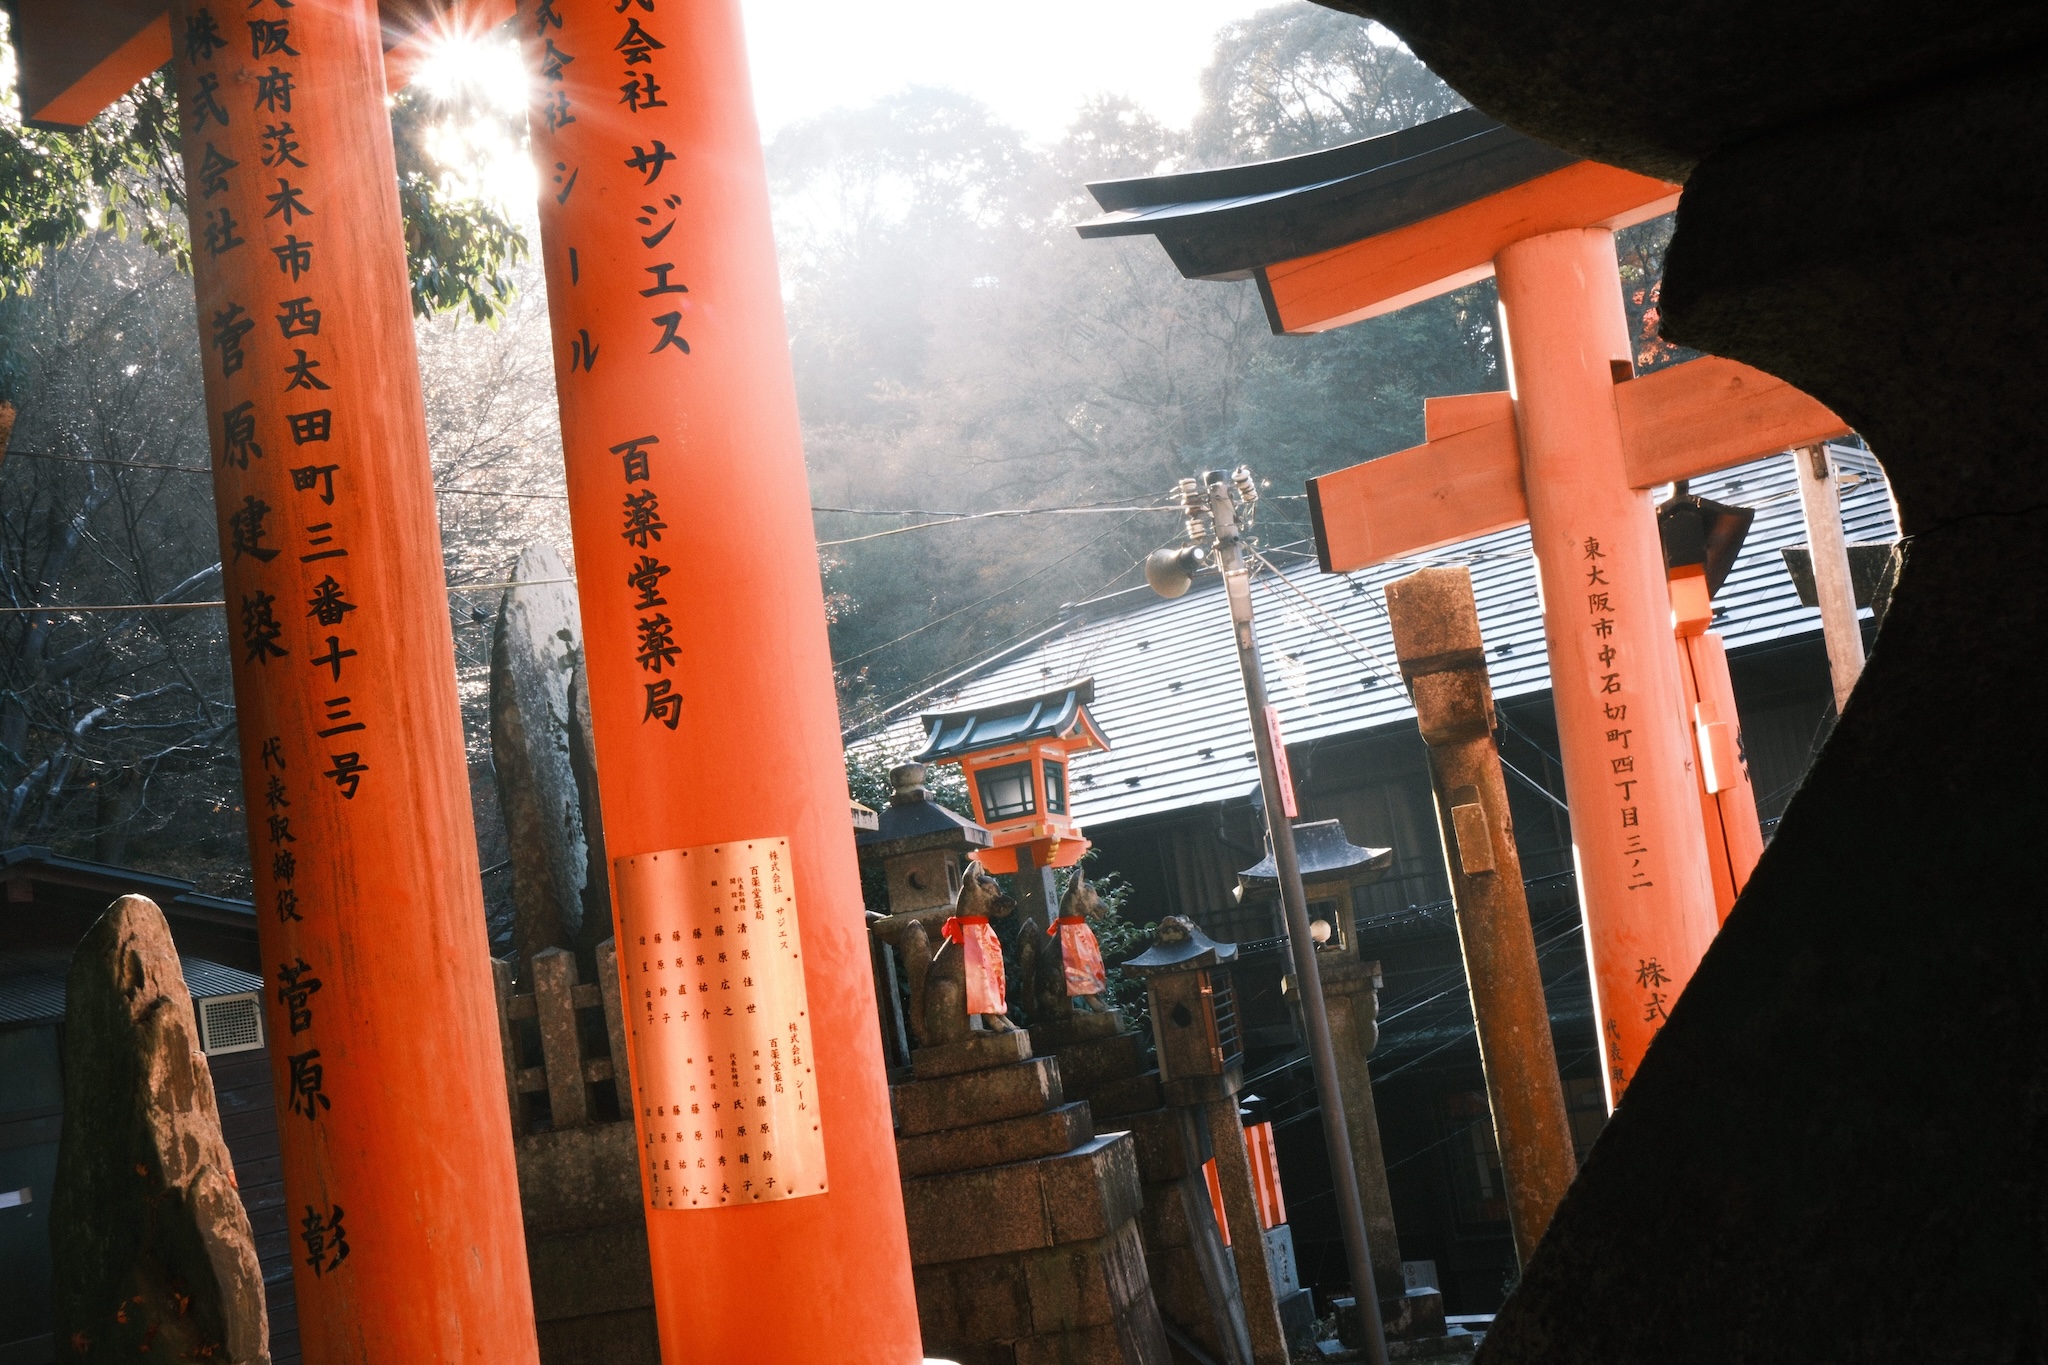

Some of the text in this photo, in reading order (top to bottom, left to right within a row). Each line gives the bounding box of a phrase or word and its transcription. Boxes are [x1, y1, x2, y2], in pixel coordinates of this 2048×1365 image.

[185, 8, 246, 260] 株式会社
[552, 160, 600, 374] シール
[246, 0, 370, 801] 阪府茨木市西太田町三番十三号
[607, 0, 691, 731] 会社 サジエス 百薬堂薬局
[210, 301, 290, 667] 菅原建築
[259, 735, 304, 924] 代表取締役
[749, 865, 765, 921] 百薬堂薬局
[769, 850, 789, 950] 株式会社 サジエス
[672, 930, 690, 1022] 藤原直子
[714, 924, 735, 1017] 藤原広之
[738, 922, 757, 1014] 清原佳世
[769, 1037, 784, 1094] 百薬堂薬局
[788, 1022, 807, 1111] 株式会社 シール
[691, 1103, 710, 1195] 藤原広之
[711, 1101, 731, 1194] 中川秀夫
